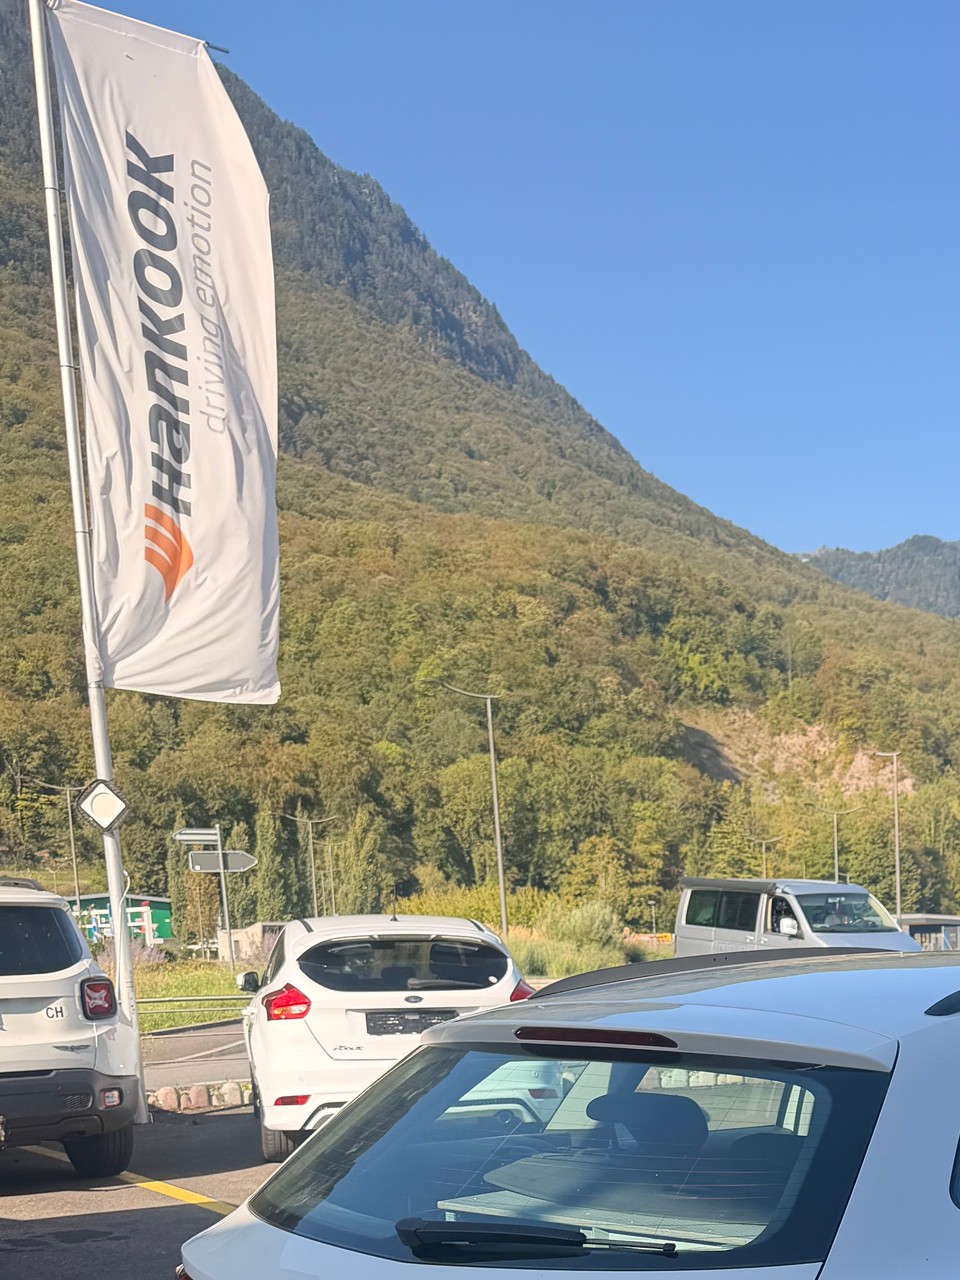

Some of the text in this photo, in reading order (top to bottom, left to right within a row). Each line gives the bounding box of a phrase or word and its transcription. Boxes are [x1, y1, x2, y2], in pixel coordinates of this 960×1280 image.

[182, 158, 227, 436] driving emotion
[45, 1006, 64, 1019] CH
